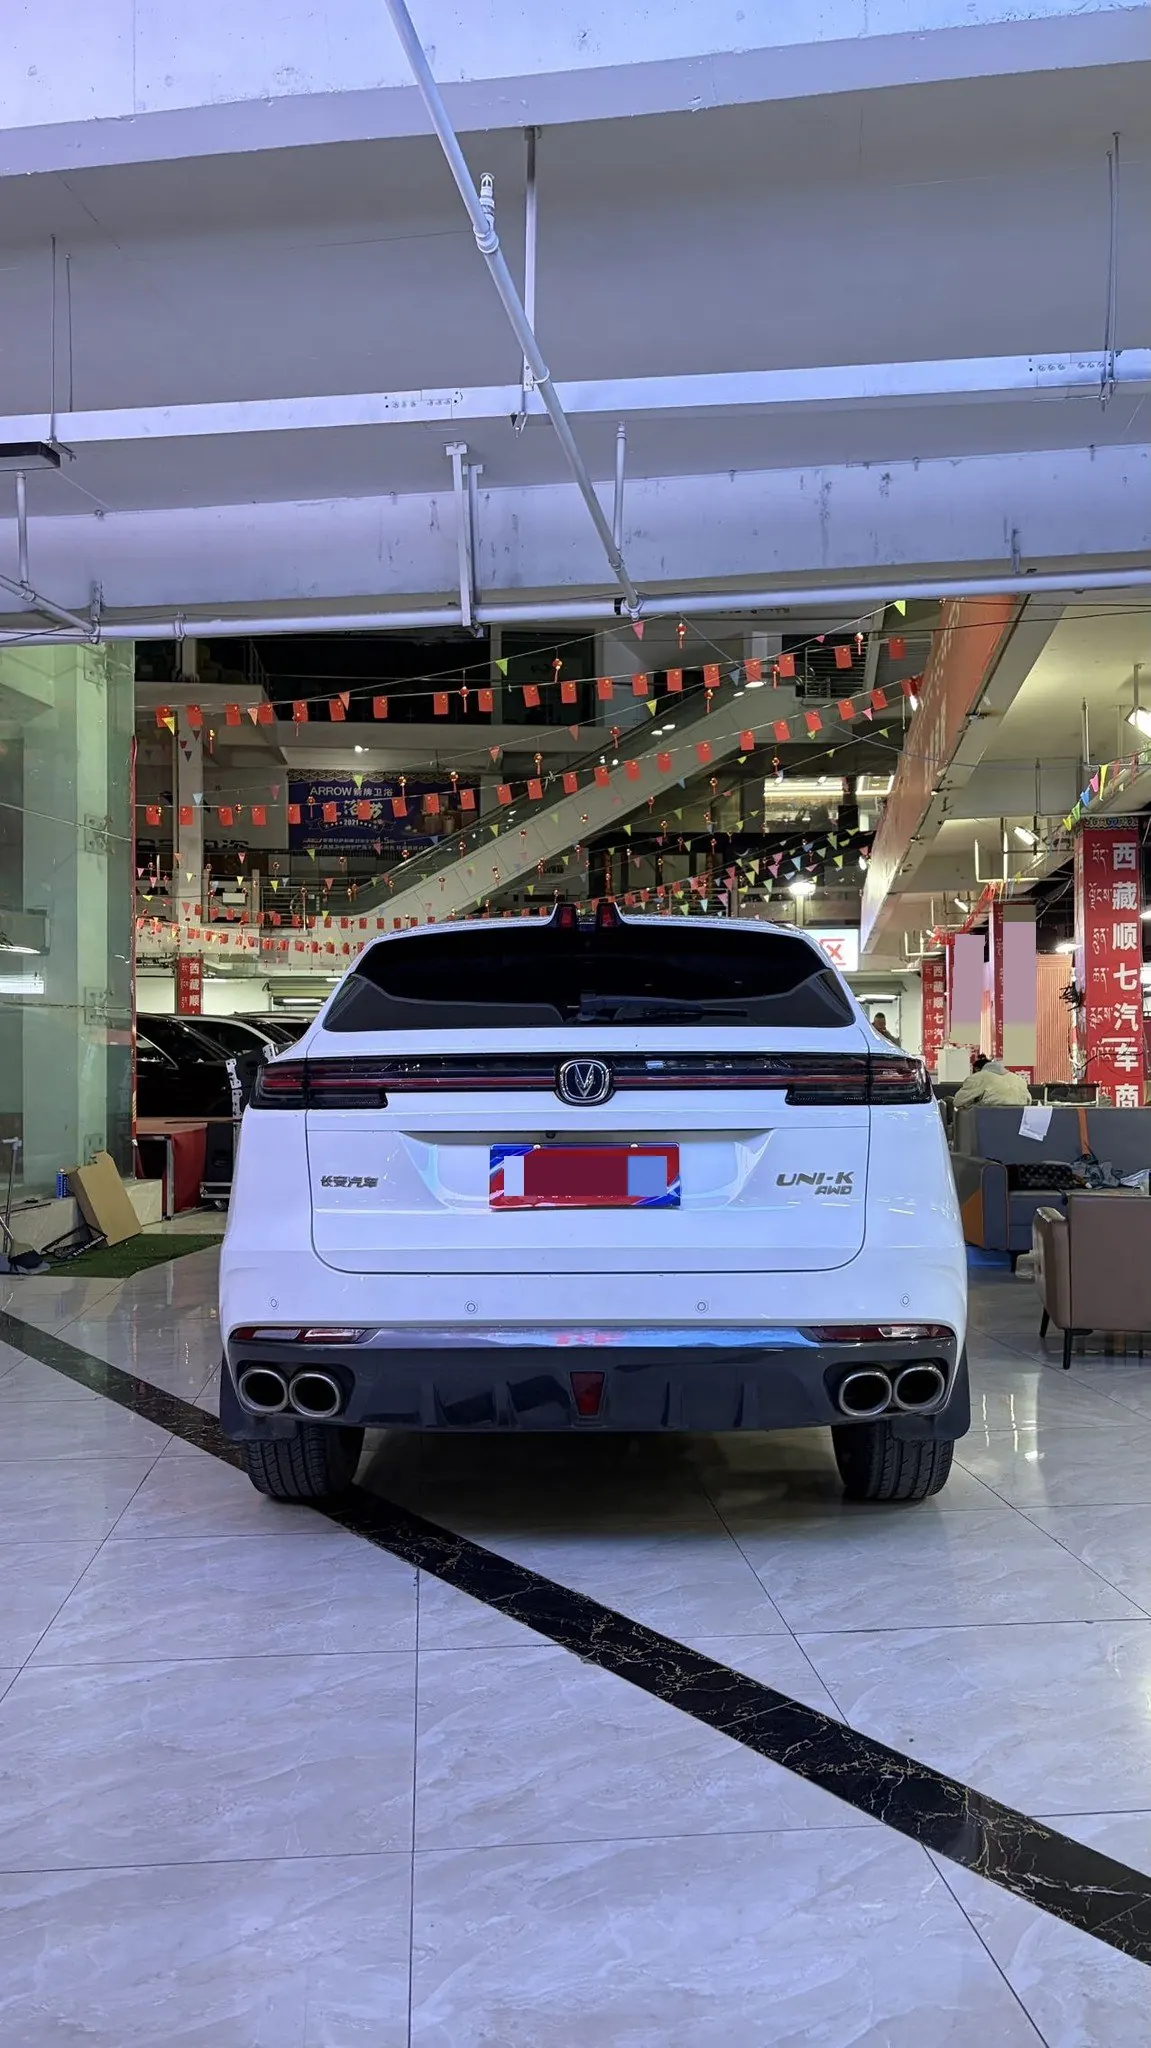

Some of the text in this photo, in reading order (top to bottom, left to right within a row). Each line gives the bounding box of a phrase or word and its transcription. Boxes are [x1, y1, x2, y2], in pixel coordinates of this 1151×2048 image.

[310, 787, 352, 796] ARROW
[320, 1175, 378, 1188] 长安汽车
[776, 1171, 855, 1187] UNI-K
[814, 1185, 853, 1195] AWD
